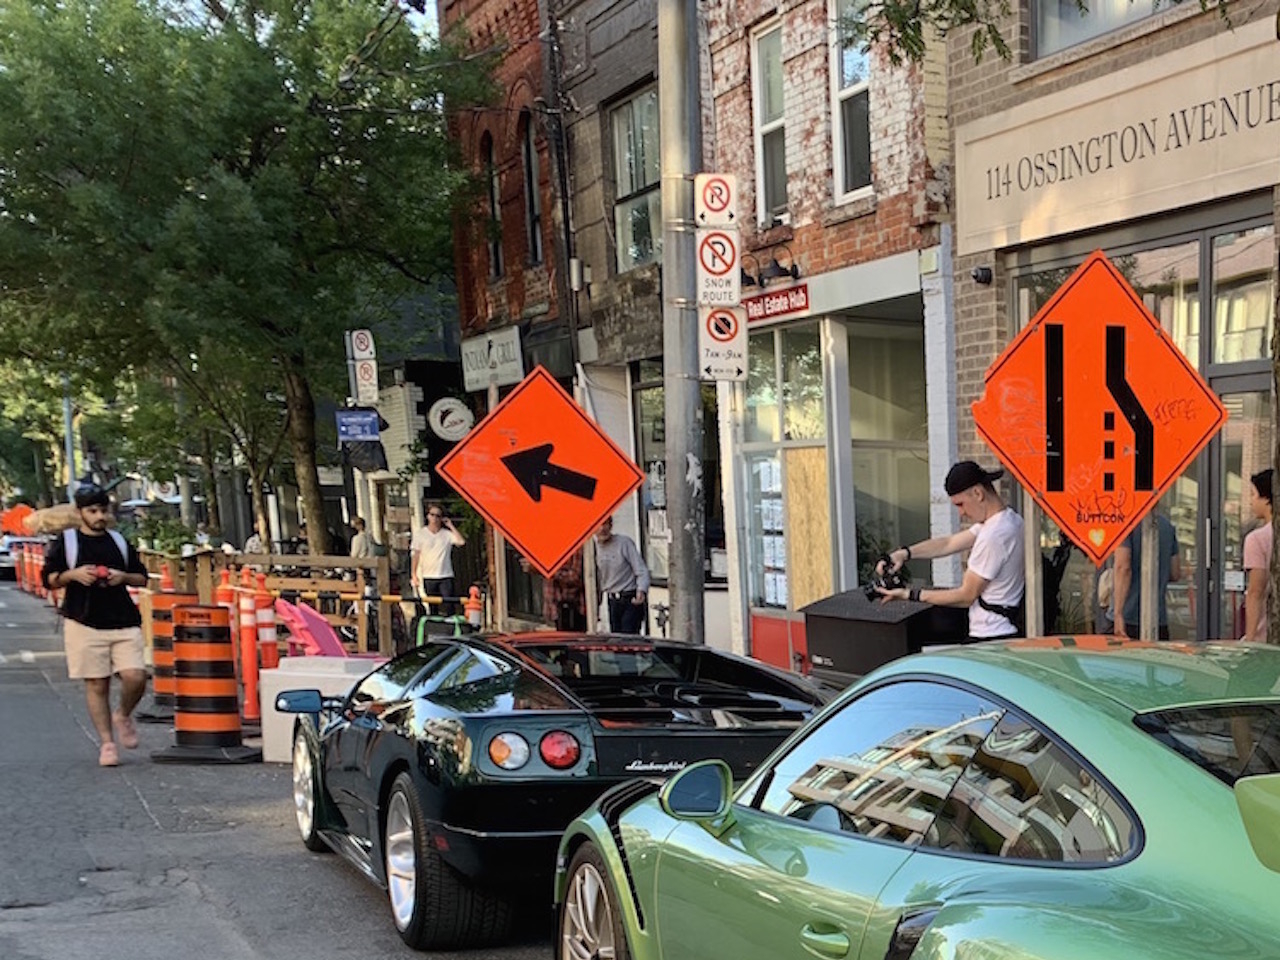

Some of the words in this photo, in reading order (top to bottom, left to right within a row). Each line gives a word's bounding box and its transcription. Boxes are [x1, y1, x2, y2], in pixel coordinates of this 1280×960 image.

[986, 161, 1012, 200] 114
[1016, 117, 1158, 192] OSSINGTON
[704, 277, 733, 289] SNOW
[703, 290, 734, 302] ROUTE
[748, 298, 763, 317] Real
[764, 294, 788, 314] Estate
[788, 287, 806, 309] Hub
[1076, 513, 1126, 523] BUTTCON
